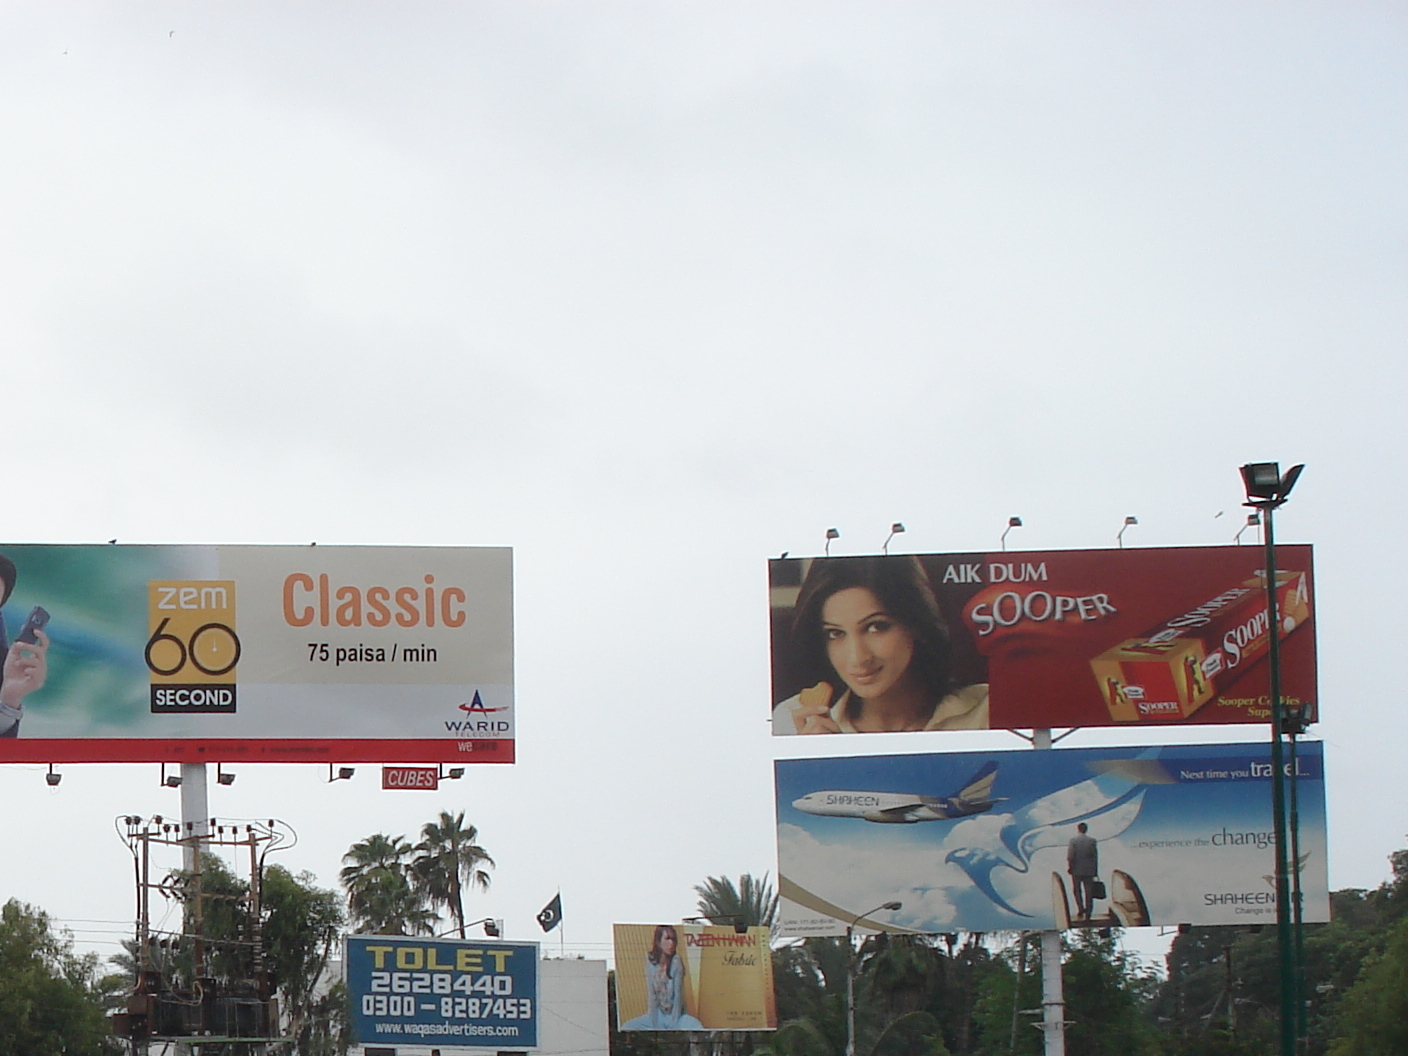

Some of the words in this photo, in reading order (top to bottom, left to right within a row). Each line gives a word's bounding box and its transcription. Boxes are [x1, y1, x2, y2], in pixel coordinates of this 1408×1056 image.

[943, 563, 982, 583] AIK
[990, 562, 1048, 582] DUM
[157, 586, 227, 610] zem
[283, 572, 467, 628] Classic
[971, 591, 1117, 636] SOOPER
[144, 617, 241, 676] 60
[307, 643, 330, 662] 75
[335, 643, 385, 666] paisa
[402, 643, 437, 662] min
[155, 689, 233, 706] SECOND
[1218, 696, 1255, 707] Sooper
[1258, 695, 1300, 705] Ckies
[444, 721, 510, 732] WARID
[388, 770, 434, 786] CUBES
[1180, 770, 1204, 780] Next
[1206, 769, 1228, 779] time
[1229, 770, 1249, 780] you
[826, 795, 880, 806] SHAHEEN
[1194, 837, 1210, 846] the
[1204, 892, 1275, 906] SHAHEEN
[1235, 906, 1263, 916] Change
[366, 945, 514, 973] TOLET
[722, 949, 757, 967] Fabric
[371, 971, 512, 996] 2628440
[362, 995, 415, 1016] 0300
[441, 997, 532, 1019] 8287453
